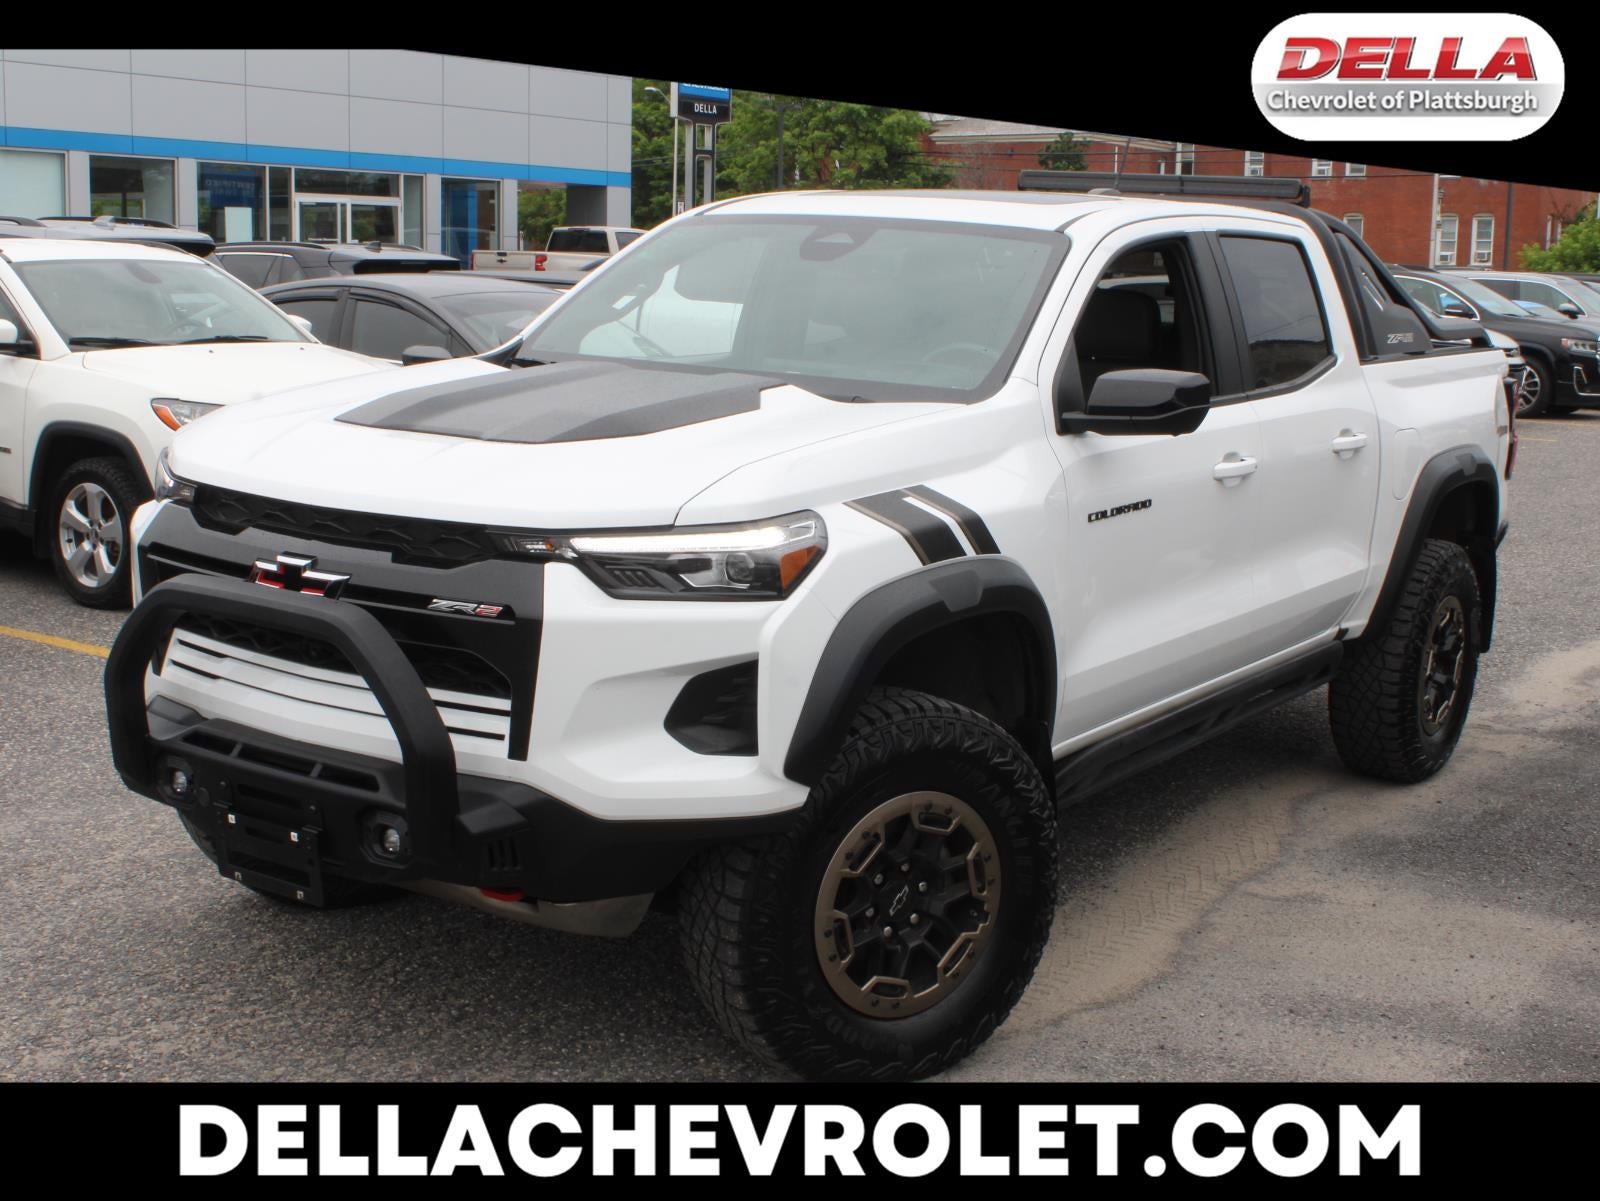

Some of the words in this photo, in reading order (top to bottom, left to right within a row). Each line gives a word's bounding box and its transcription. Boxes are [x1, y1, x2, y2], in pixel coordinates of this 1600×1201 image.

[694, 103, 717, 114] DELLA
[1087, 498, 1153, 523] COLORADO
[427, 598, 503, 618] ZR2
